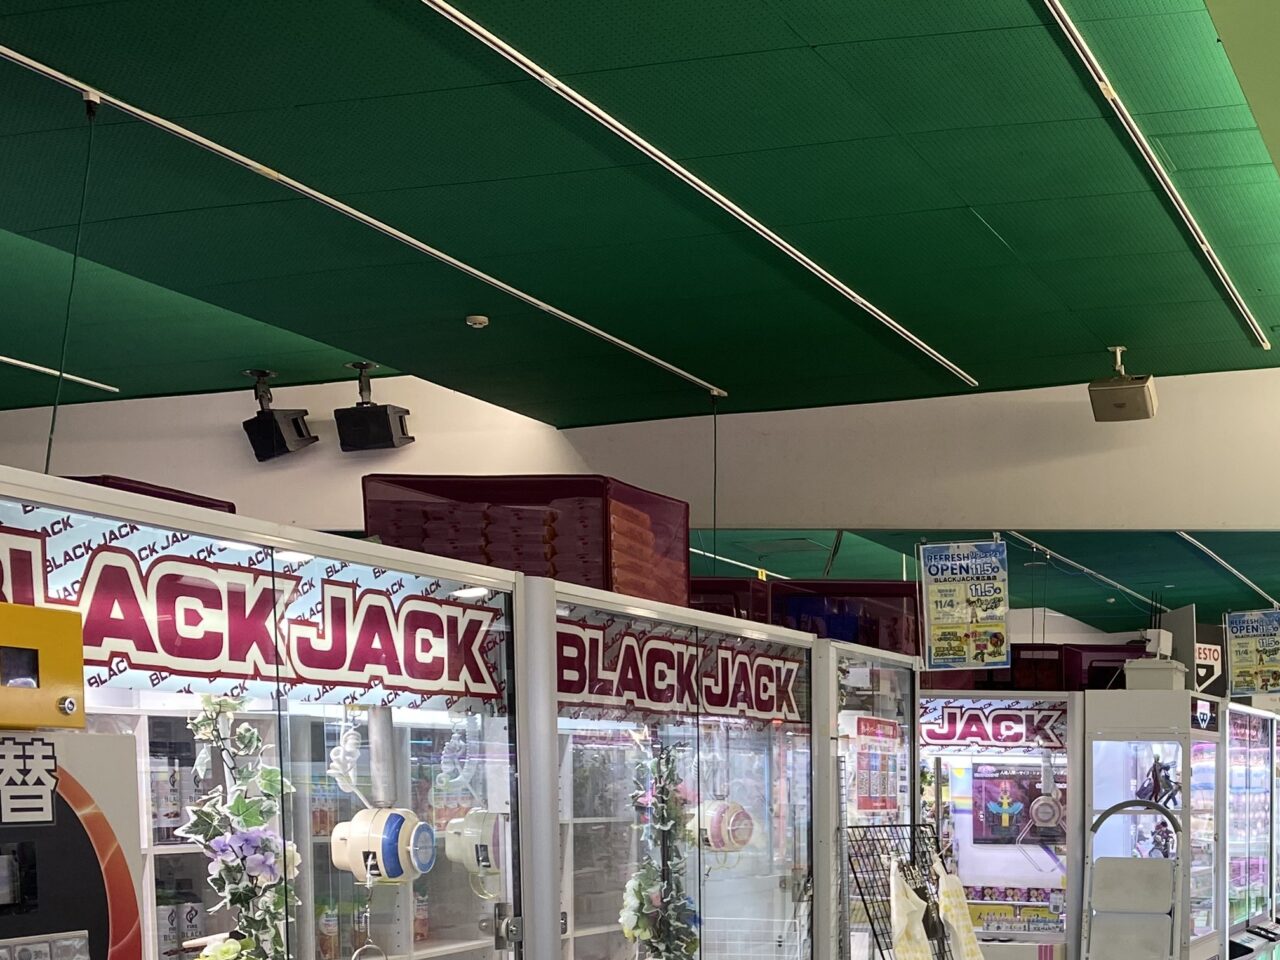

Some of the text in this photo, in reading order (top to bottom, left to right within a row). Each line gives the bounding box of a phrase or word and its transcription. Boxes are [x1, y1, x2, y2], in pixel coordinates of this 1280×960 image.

[927, 553, 969, 562] REFRESH
[928, 563, 969, 576] OPEN
[292, 588, 492, 692] JACK
[1231, 626, 1258, 634] OPEN
[87, 659, 128, 688] BLAC
[557, 630, 796, 715] BLACK JACK
[924, 711, 1056, 743] JACK
[0, 737, 58, 823] 替
